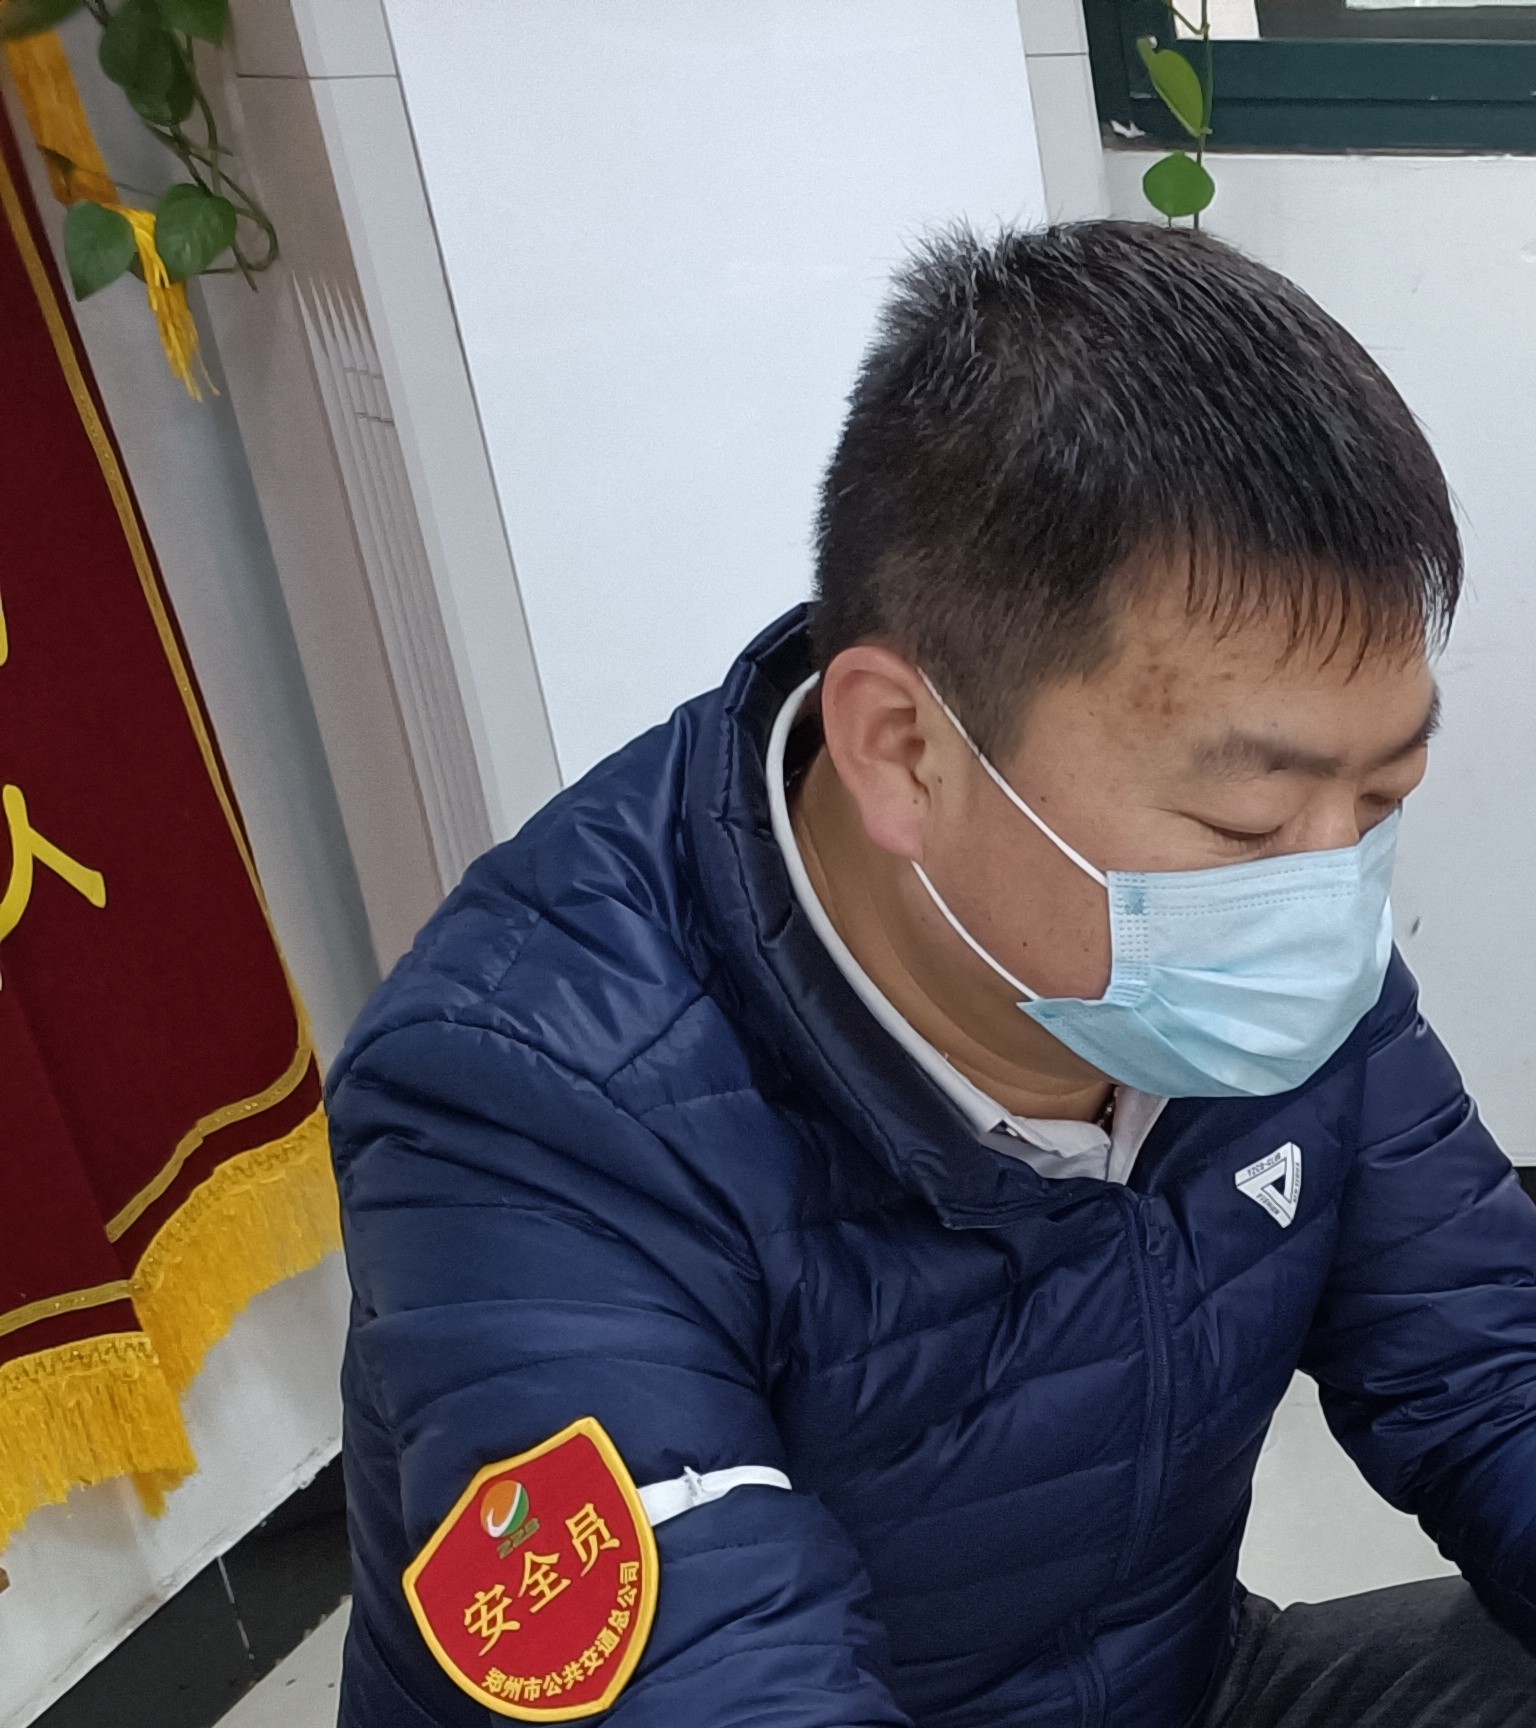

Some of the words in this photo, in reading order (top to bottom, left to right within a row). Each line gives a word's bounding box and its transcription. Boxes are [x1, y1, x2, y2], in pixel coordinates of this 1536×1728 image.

[464, 1503, 620, 1657] 安全员
[481, 1561, 640, 1702] 郑州市公共交通总公司
